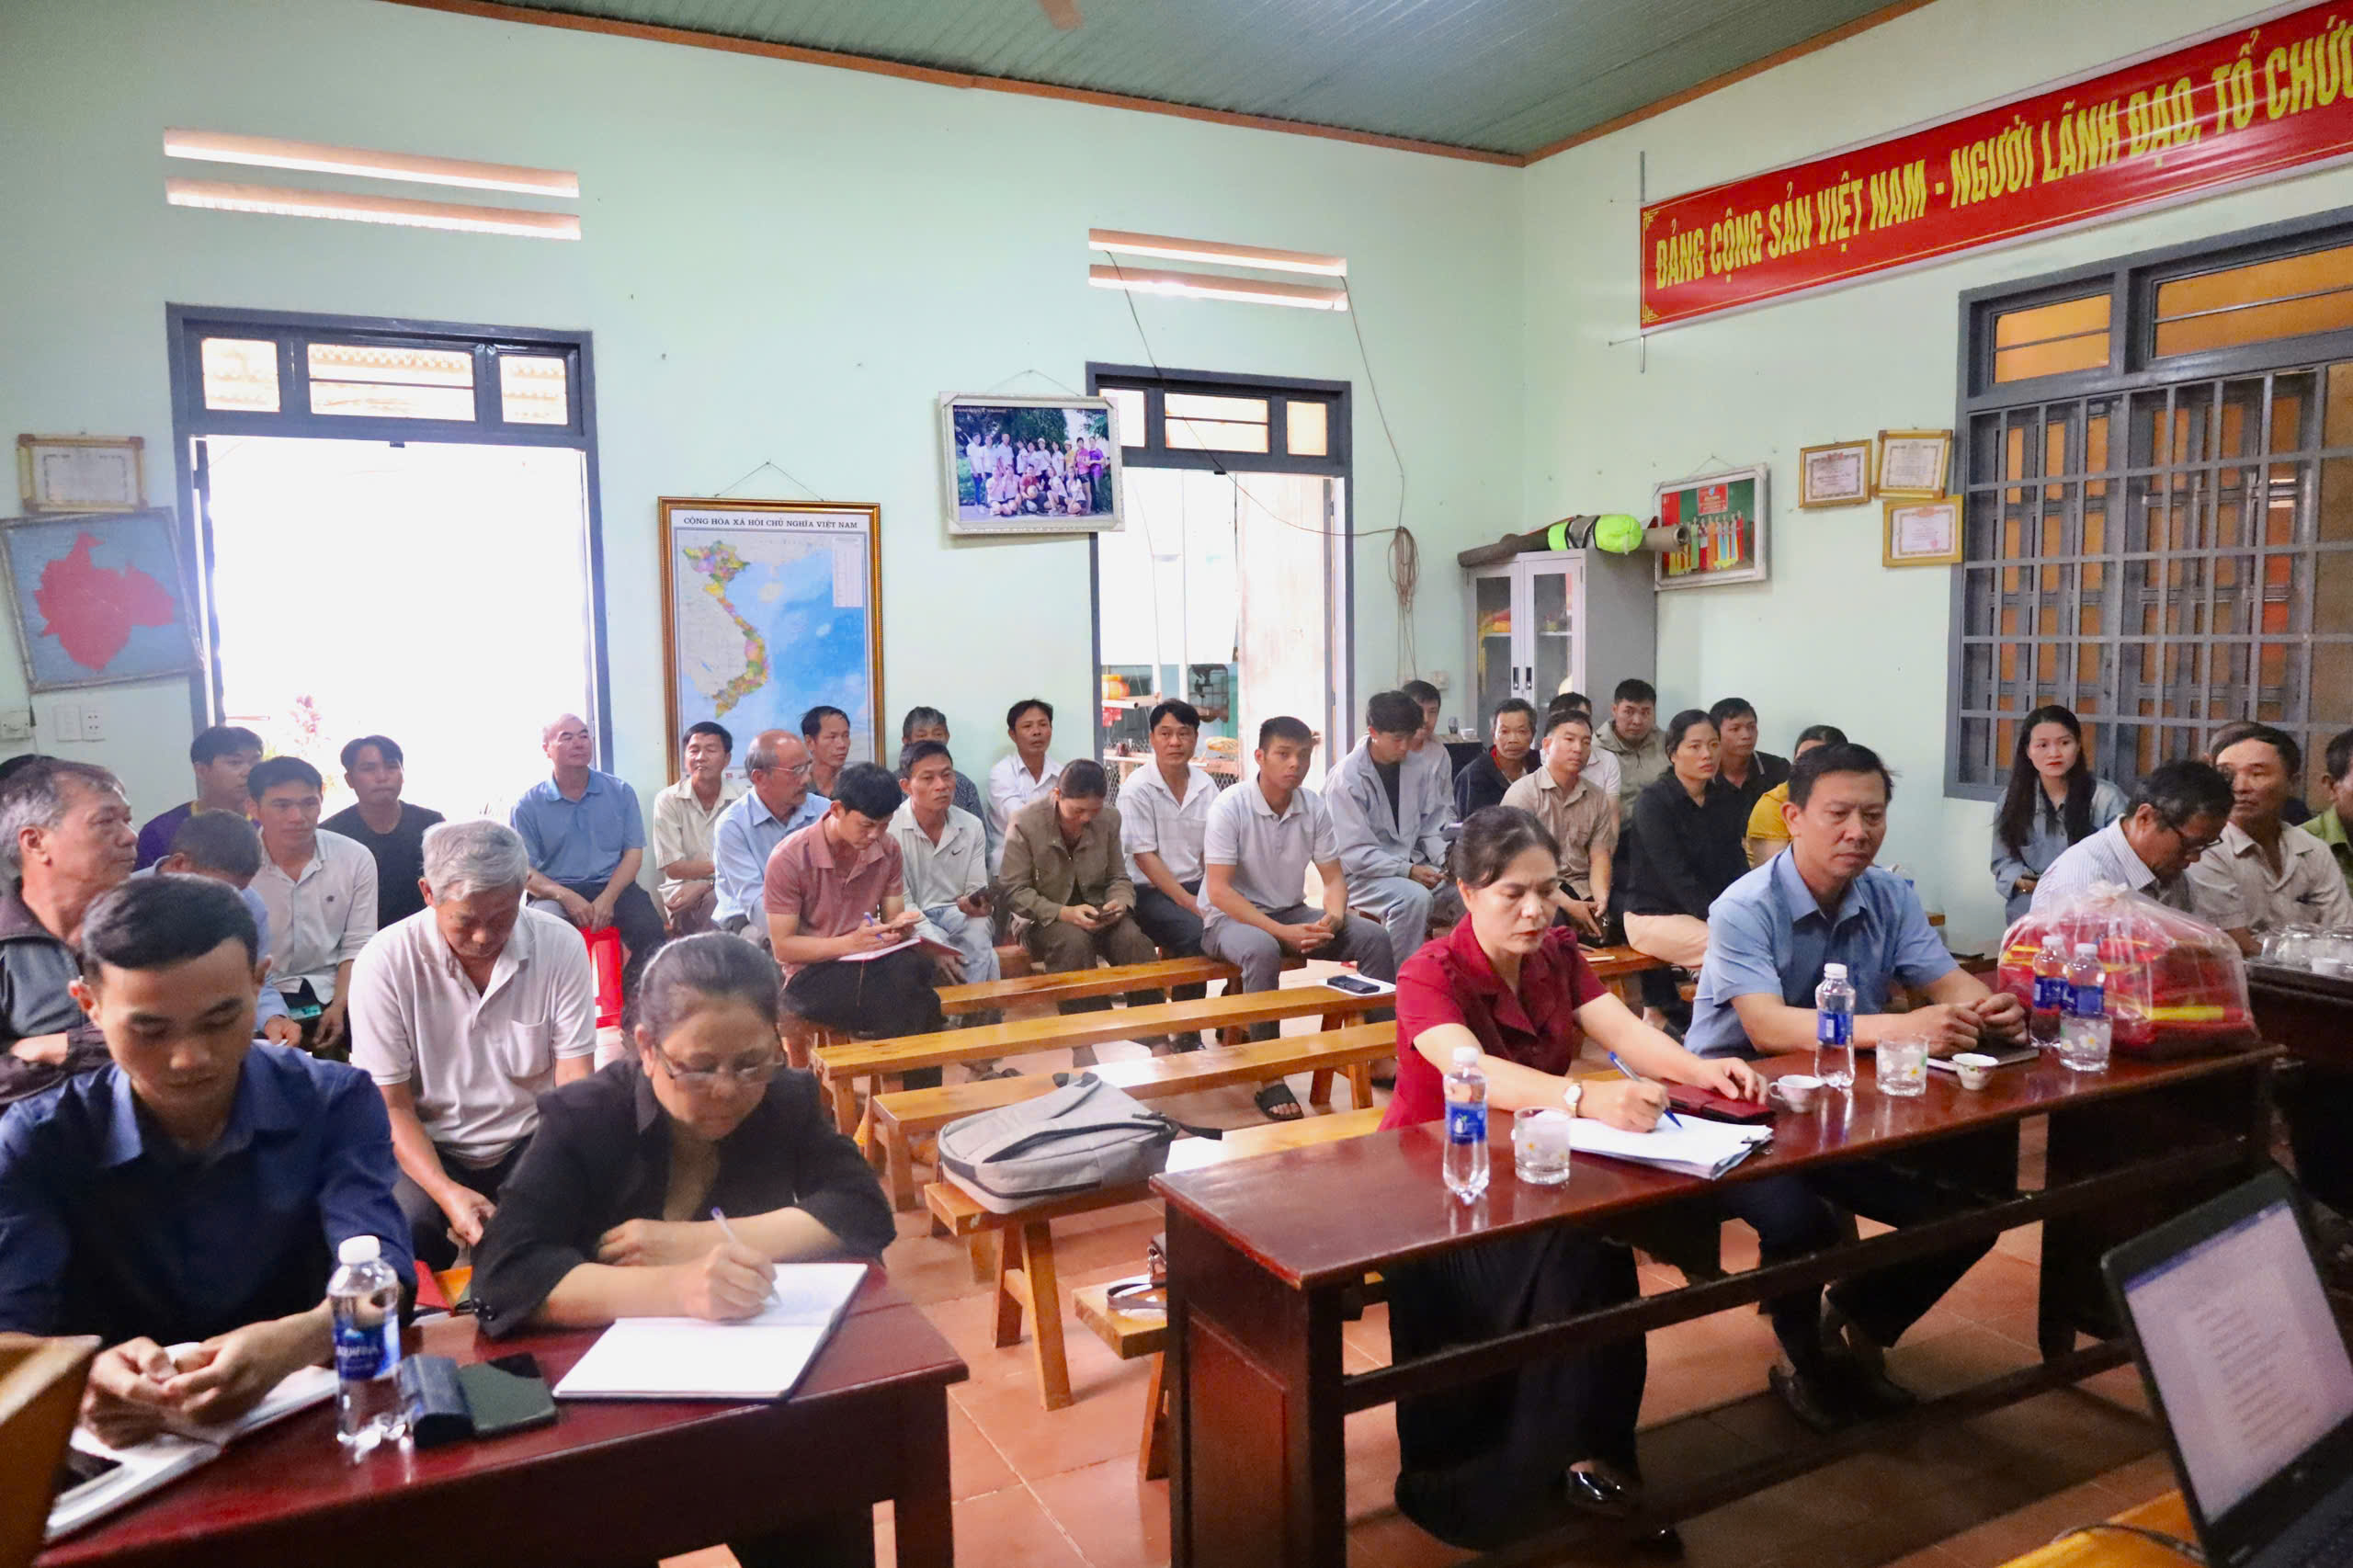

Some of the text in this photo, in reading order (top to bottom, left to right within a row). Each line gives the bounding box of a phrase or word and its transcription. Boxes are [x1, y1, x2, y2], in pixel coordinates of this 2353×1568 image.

[1655, 218, 1705, 290] ĐẢNG
[1710, 207, 1764, 283] CỘNG
[1768, 181, 1813, 259] SẢN
[1817, 170, 1863, 253] VIỆT
[1870, 159, 1927, 231] NAM
[1935, 181, 1945, 195] -
[1950, 114, 2035, 210] NGƯỜI
[2041, 99, 2120, 184] LÃNH
[2127, 76, 2201, 168] ĐẠO,
[2211, 28, 2260, 135] TỔ
[683, 517, 710, 526] CỘNG
[710, 517, 731, 527] HÒA
[748, 517, 764, 528] HỘI
[816, 519, 836, 529] VIỆT
[838, 521, 858, 529] NAM
